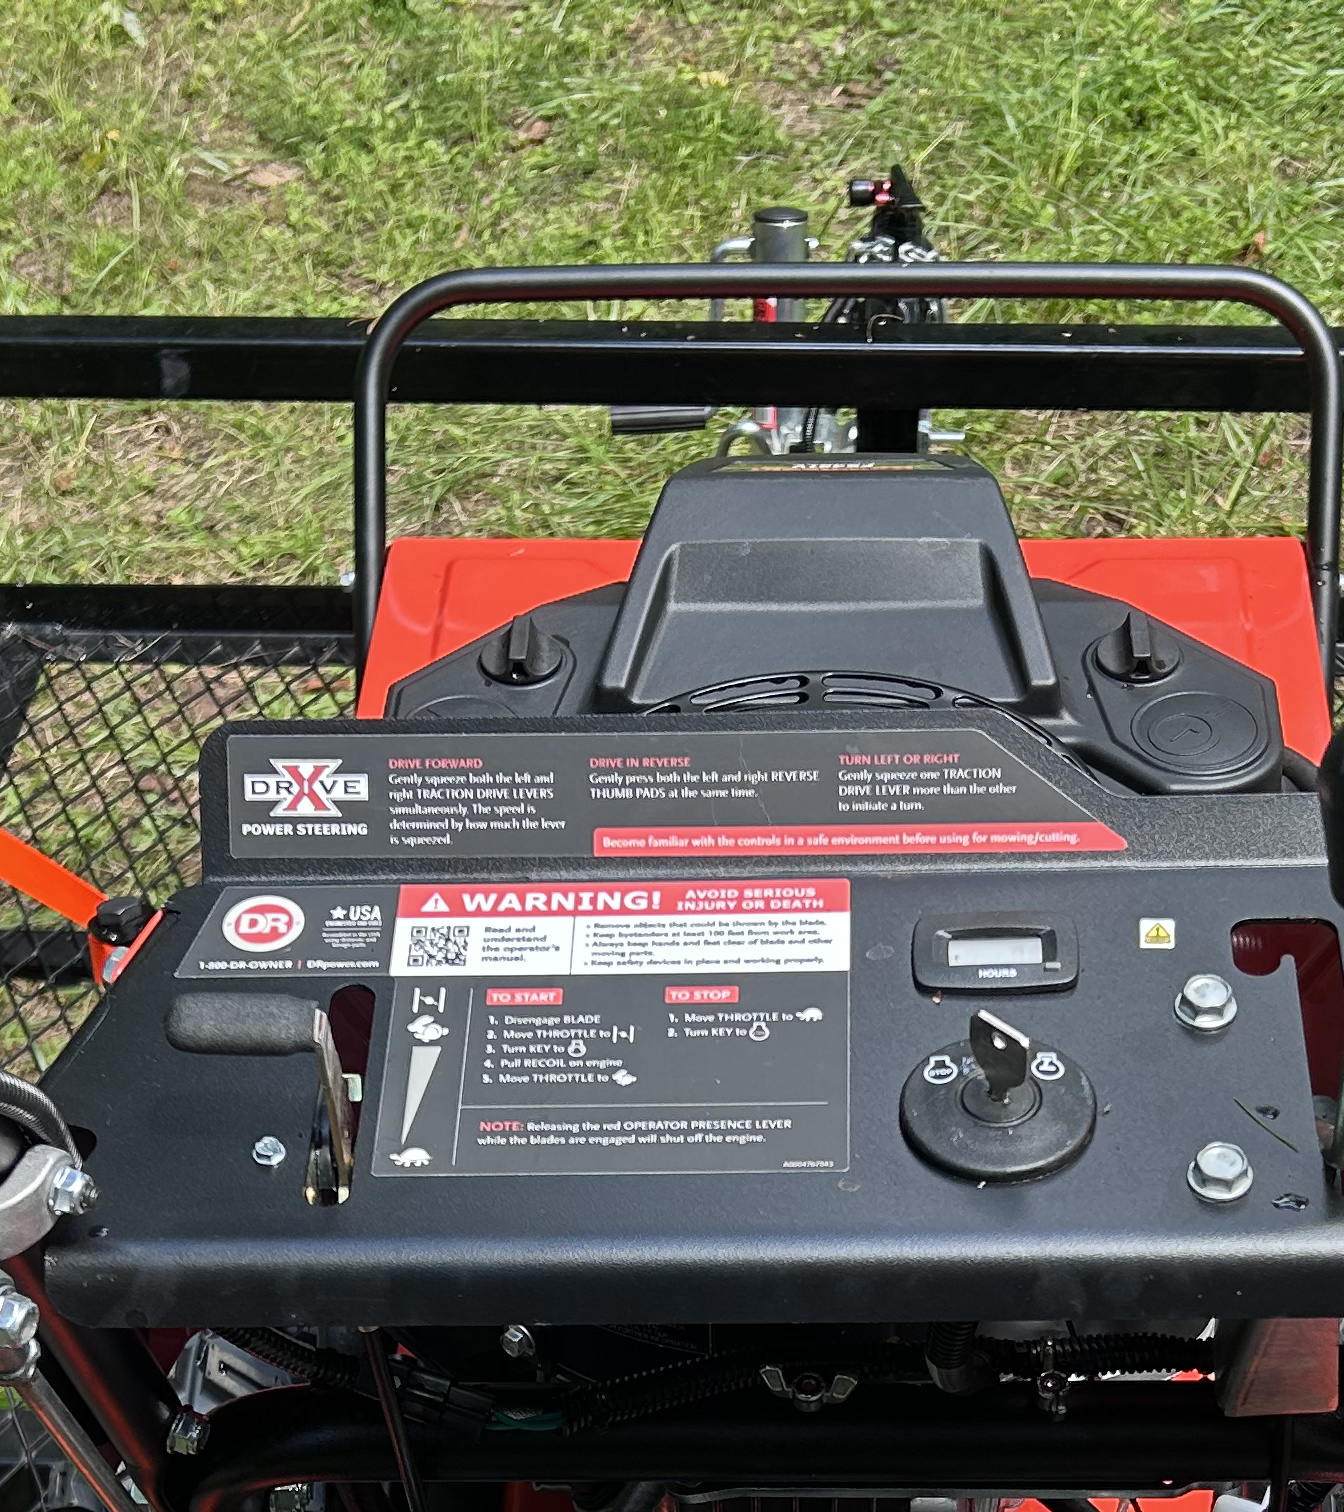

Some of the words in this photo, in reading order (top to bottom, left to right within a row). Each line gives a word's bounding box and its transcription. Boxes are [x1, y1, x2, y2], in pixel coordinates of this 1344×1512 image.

[388, 758, 421, 768] DRIVE
[425, 758, 482, 768] FORWARD
[589, 757, 622, 768] DRIVE
[626, 757, 639, 767] IN
[642, 757, 690, 767] REVERSE
[839, 754, 871, 765] TURN
[874, 754, 900, 764] LEFT
[902, 754, 920, 764] OR
[923, 753, 960, 764] RIGHT
[388, 772, 422, 787] Gently
[424, 775, 467, 787] squeeze
[468, 772, 493, 783] both
[495, 772, 512, 783] the
[514, 771, 531, 783] left
[533, 771, 553, 783] and
[588, 771, 623, 786] Gently
[625, 775, 653, 785] press
[656, 771, 680, 783] both
[682, 771, 700, 782] the
[702, 771, 718, 782] left
[721, 770, 741, 782] and
[743, 770, 768, 784] right
[771, 770, 819, 781] REVERSE
[838, 769, 872, 783] Gently
[875, 771, 917, 783] squeeze
[919, 771, 940, 779] one
[942, 767, 1001, 779] TRACTION
[388, 788, 413, 802] right
[416, 788, 473, 799] TRACTION
[476, 788, 509, 799] DRIVE
[512, 787, 554, 799] LEVERS
[590, 787, 633, 799] THUMB
[635, 787, 665, 798] PADS
[668, 788, 678, 798] at
[680, 786, 698, 798] the
[700, 789, 728, 797] same
[730, 788, 758, 797] time.
[838, 785, 871, 796] DRIVE
[875, 784, 910, 795] LEVER
[912, 786, 940, 795] more
[942, 783, 967, 794] than
[969, 783, 986, 793] the
[988, 783, 1016, 793] other
[389, 802, 468, 817] simultaneously.
[472, 803, 491, 814] The
[493, 802, 524, 817] speed
[526, 804, 536, 813] is
[838, 801, 849, 811] to
[851, 801, 888, 811] initiate
[890, 802, 896, 810] a
[899, 800, 924, 810] turn.
[242, 823, 293, 835] POWER
[296, 822, 367, 835] STEERING
[389, 818, 448, 829] determined
[450, 818, 463, 832] by
[465, 818, 488, 829] how
[490, 817, 519, 829] much
[522, 817, 539, 829] the
[540, 817, 565, 829] lever
[390, 836, 399, 844] is
[401, 833, 452, 847] squeezed.
[602, 836, 646, 848] Become
[647, 835, 689, 847] familiar
[691, 835, 715, 846] with
[717, 835, 735, 846] the
[737, 834, 781, 846] controls
[783, 835, 794, 845] in
[797, 837, 804, 845] a
[806, 833, 829, 845] safe
[830, 834, 899, 845] environment
[902, 832, 936, 844] before
[939, 833, 970, 846] using
[971, 832, 988, 843] for
[989, 831, 1080, 845] mowing/cutting.
[685, 889, 738, 898] AVOID
[743, 887, 816, 898] SERIOUS
[461, 890, 660, 911] WARNING!
[677, 900, 736, 910] INJURY
[741, 899, 764, 909] OR
[770, 898, 824, 909] DEATH
[349, 905, 382, 921] USA
[238, 912, 290, 934] DR
[978, 968, 1017, 978] HOURS
[492, 993, 511, 1002] TO
[515, 992, 556, 1002] START
[670, 991, 690, 1000] TO
[693, 990, 730, 1000] STOP
[488, 1015, 498, 1025] 1.
[504, 1015, 560, 1026] Disengage
[563, 1014, 600, 1024] BLADE
[668, 1013, 678, 1023] 1.
[684, 1013, 715, 1022] Move
[717, 1012, 778, 1023] THROTTLE
[781, 1012, 793, 1021] to
[486, 1029, 497, 1039] 2.
[502, 1029, 533, 1038] Move
[535, 1028, 596, 1038] THROTTLE
[598, 1029, 611, 1038] to
[667, 1027, 677, 1037] 2.
[683, 1027, 708, 1036] Turn
[711, 1027, 733, 1036] KEY
[735, 1027, 747, 1036] to
[485, 1044, 495, 1053] 3.
[501, 1044, 526, 1053] Turn
[528, 1044, 551, 1053] KEY
[552, 1044, 565, 1053] to
[483, 1059, 494, 1068] 4.
[500, 1058, 521, 1068] Pull
[523, 1058, 566, 1067] RECOIL
[585, 1059, 624, 1069] engine
[482, 1073, 492, 1083] 5.
[498, 1073, 529, 1083] Move
[532, 1073, 594, 1083] THROTTLE
[596, 1073, 609, 1082] to
[479, 1121, 524, 1131] NOTE:
[526, 1121, 579, 1133] Releasing
[581, 1121, 600, 1130] the
[602, 1120, 621, 1130] red
[622, 1120, 688, 1130] OPERATOR
[690, 1119, 752, 1129] PRESENCE
[755, 1119, 791, 1129] LEVER
[476, 1135, 506, 1145] while
[508, 1135, 527, 1144] the
[529, 1135, 565, 1144] blades
[568, 1136, 586, 1144] are
[588, 1134, 635, 1146] engaged
[637, 1134, 657, 1143] will
[659, 1134, 684, 1143] shut
[686, 1133, 704, 1142] off
[704, 1133, 723, 1142] the
[725, 1133, 766, 1144] engine.
